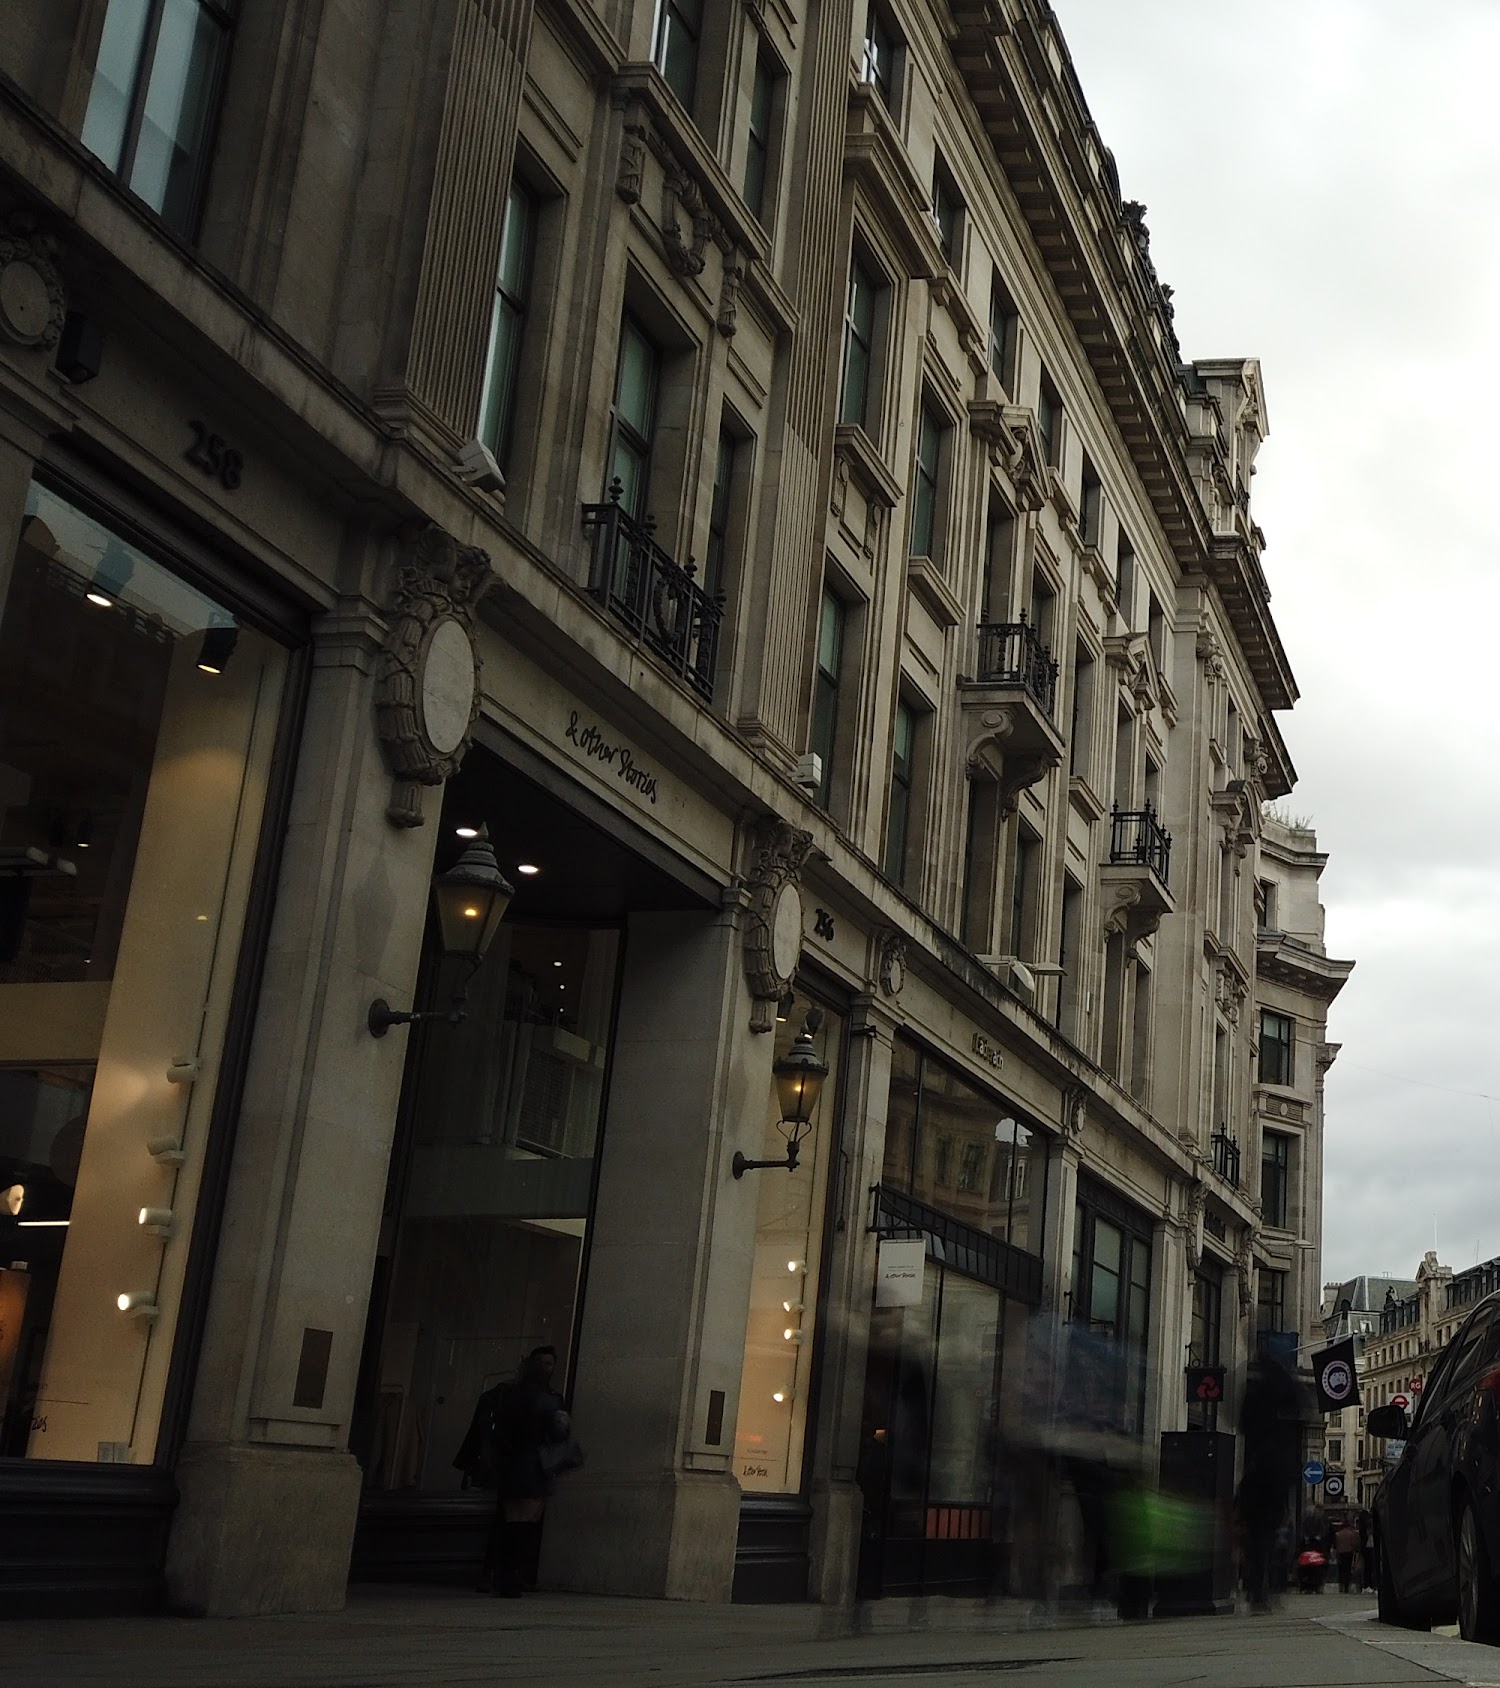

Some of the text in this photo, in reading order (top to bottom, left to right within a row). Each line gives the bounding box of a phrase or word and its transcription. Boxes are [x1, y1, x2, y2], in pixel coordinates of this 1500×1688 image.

[183, 419, 244, 490] 258
[565, 710, 657, 804] & other Stories
[814, 908, 835, 941] 256
